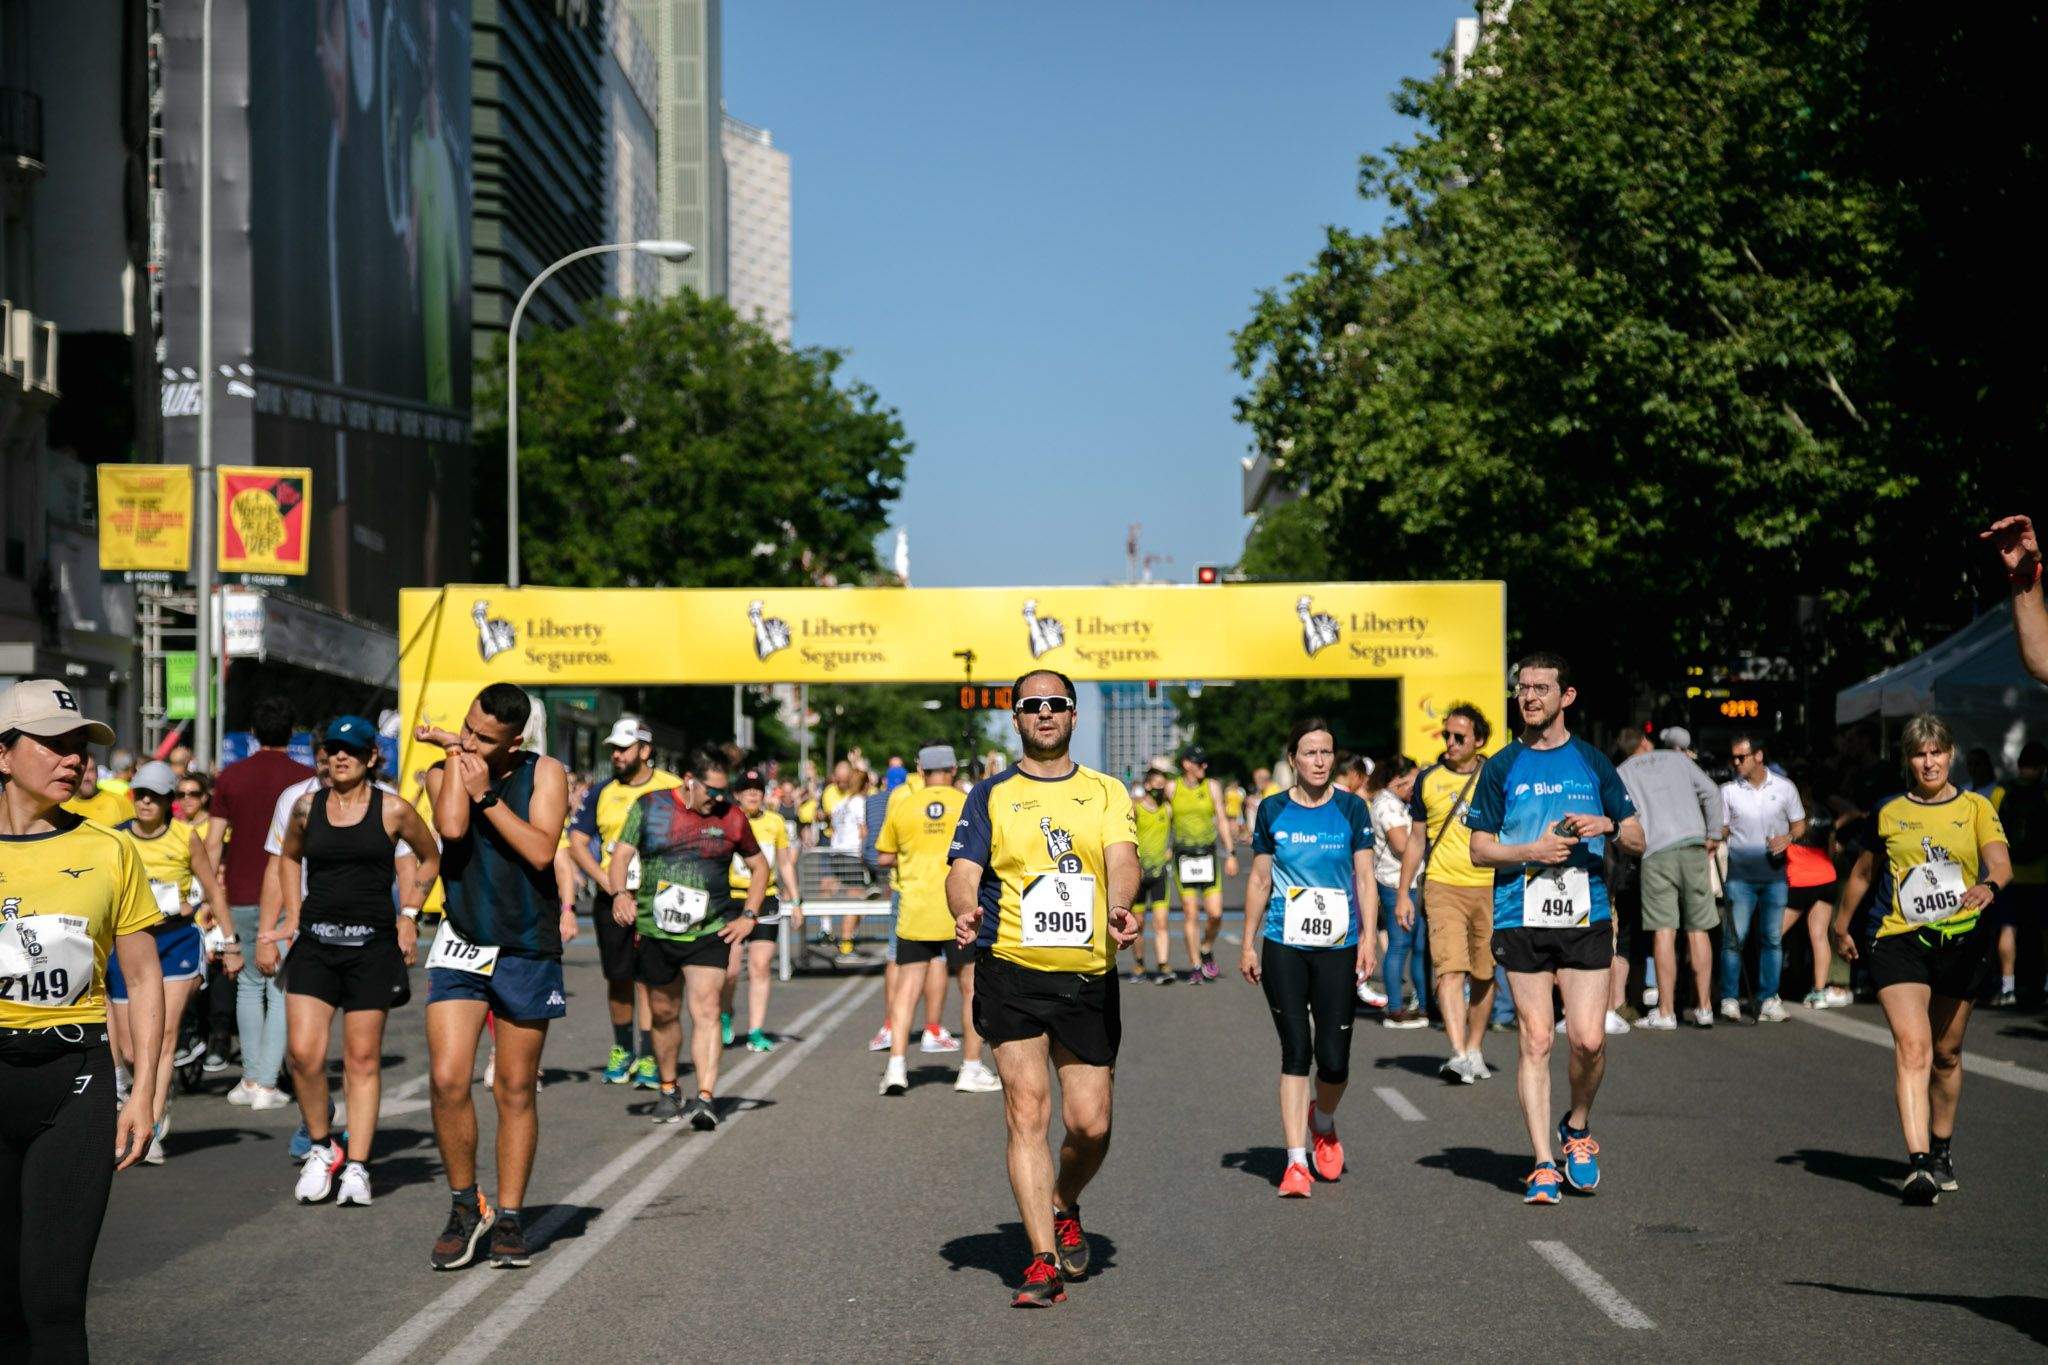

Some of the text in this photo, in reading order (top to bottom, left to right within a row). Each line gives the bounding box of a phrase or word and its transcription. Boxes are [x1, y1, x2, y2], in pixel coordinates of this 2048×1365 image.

[526, 617, 604, 645] Liberty
[801, 617, 880, 645] Liberty
[1076, 616, 1153, 642] Liberty
[1351, 612, 1429, 639] Liberty
[52, 690, 78, 712] B
[1061, 859, 1078, 873] 13
[1542, 898, 1574, 916] 494
[1913, 890, 1957, 914] 3405
[1035, 911, 1087, 932] 3905
[1301, 918, 1332, 936] 489
[444, 940, 480, 960] 1175
[0, 968, 69, 1001] 2149
